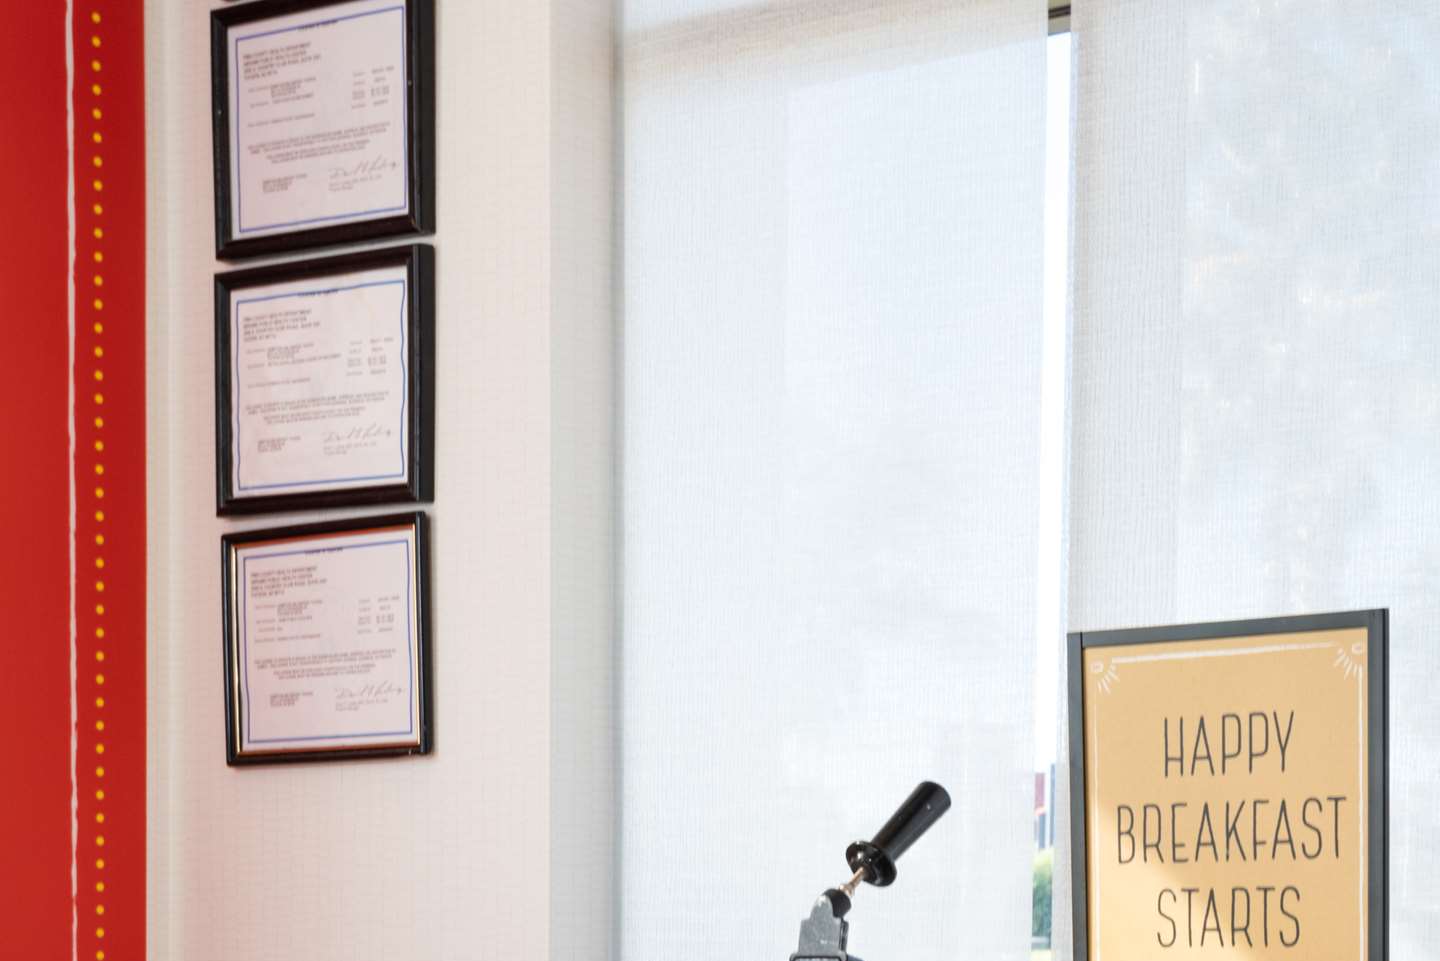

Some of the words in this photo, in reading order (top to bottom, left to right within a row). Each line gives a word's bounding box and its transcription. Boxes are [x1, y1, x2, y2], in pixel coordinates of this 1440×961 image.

[1163, 710, 1295, 779] HAPPY
[1116, 796, 1347, 865] BREAKFAST
[1156, 885, 1302, 949] STARTS
